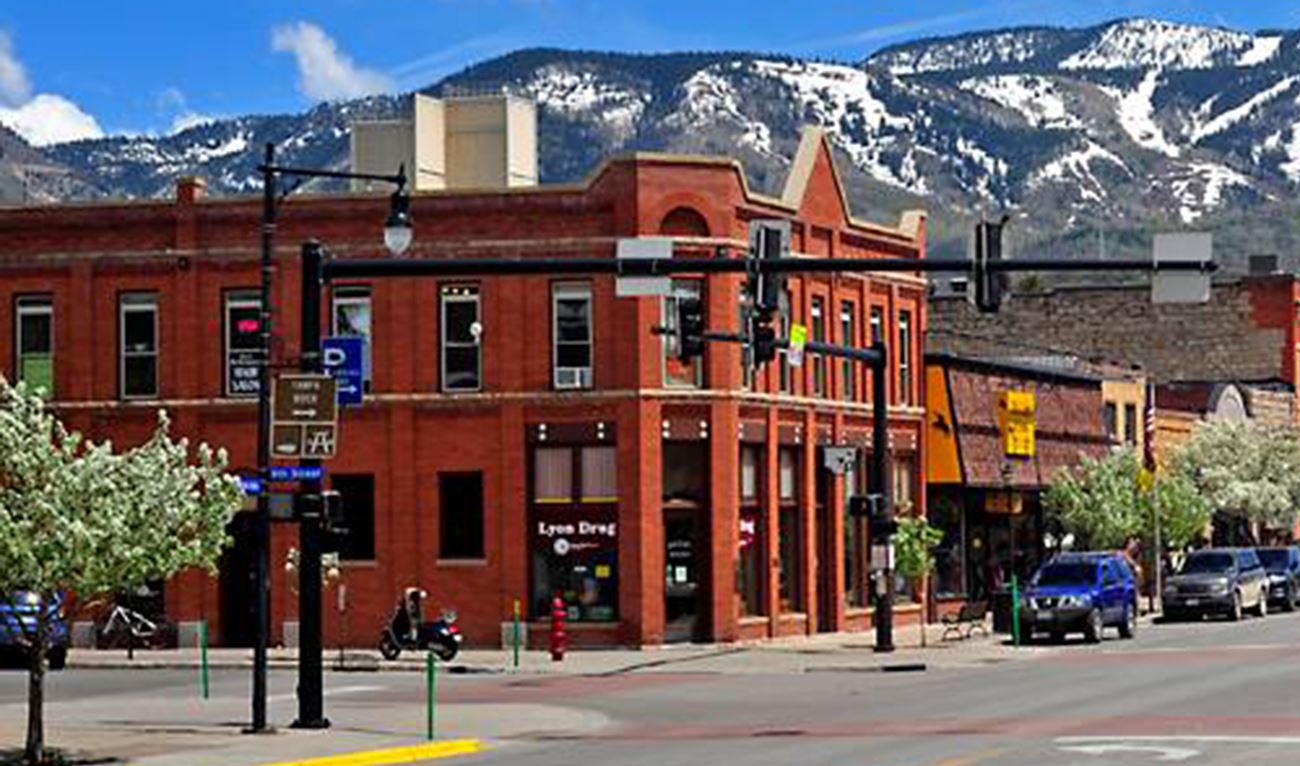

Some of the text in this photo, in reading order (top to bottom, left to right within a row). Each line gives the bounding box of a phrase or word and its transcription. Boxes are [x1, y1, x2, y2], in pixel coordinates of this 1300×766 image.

[324, 348, 346, 365] P
[538, 521, 616, 537] Lyon Drug
